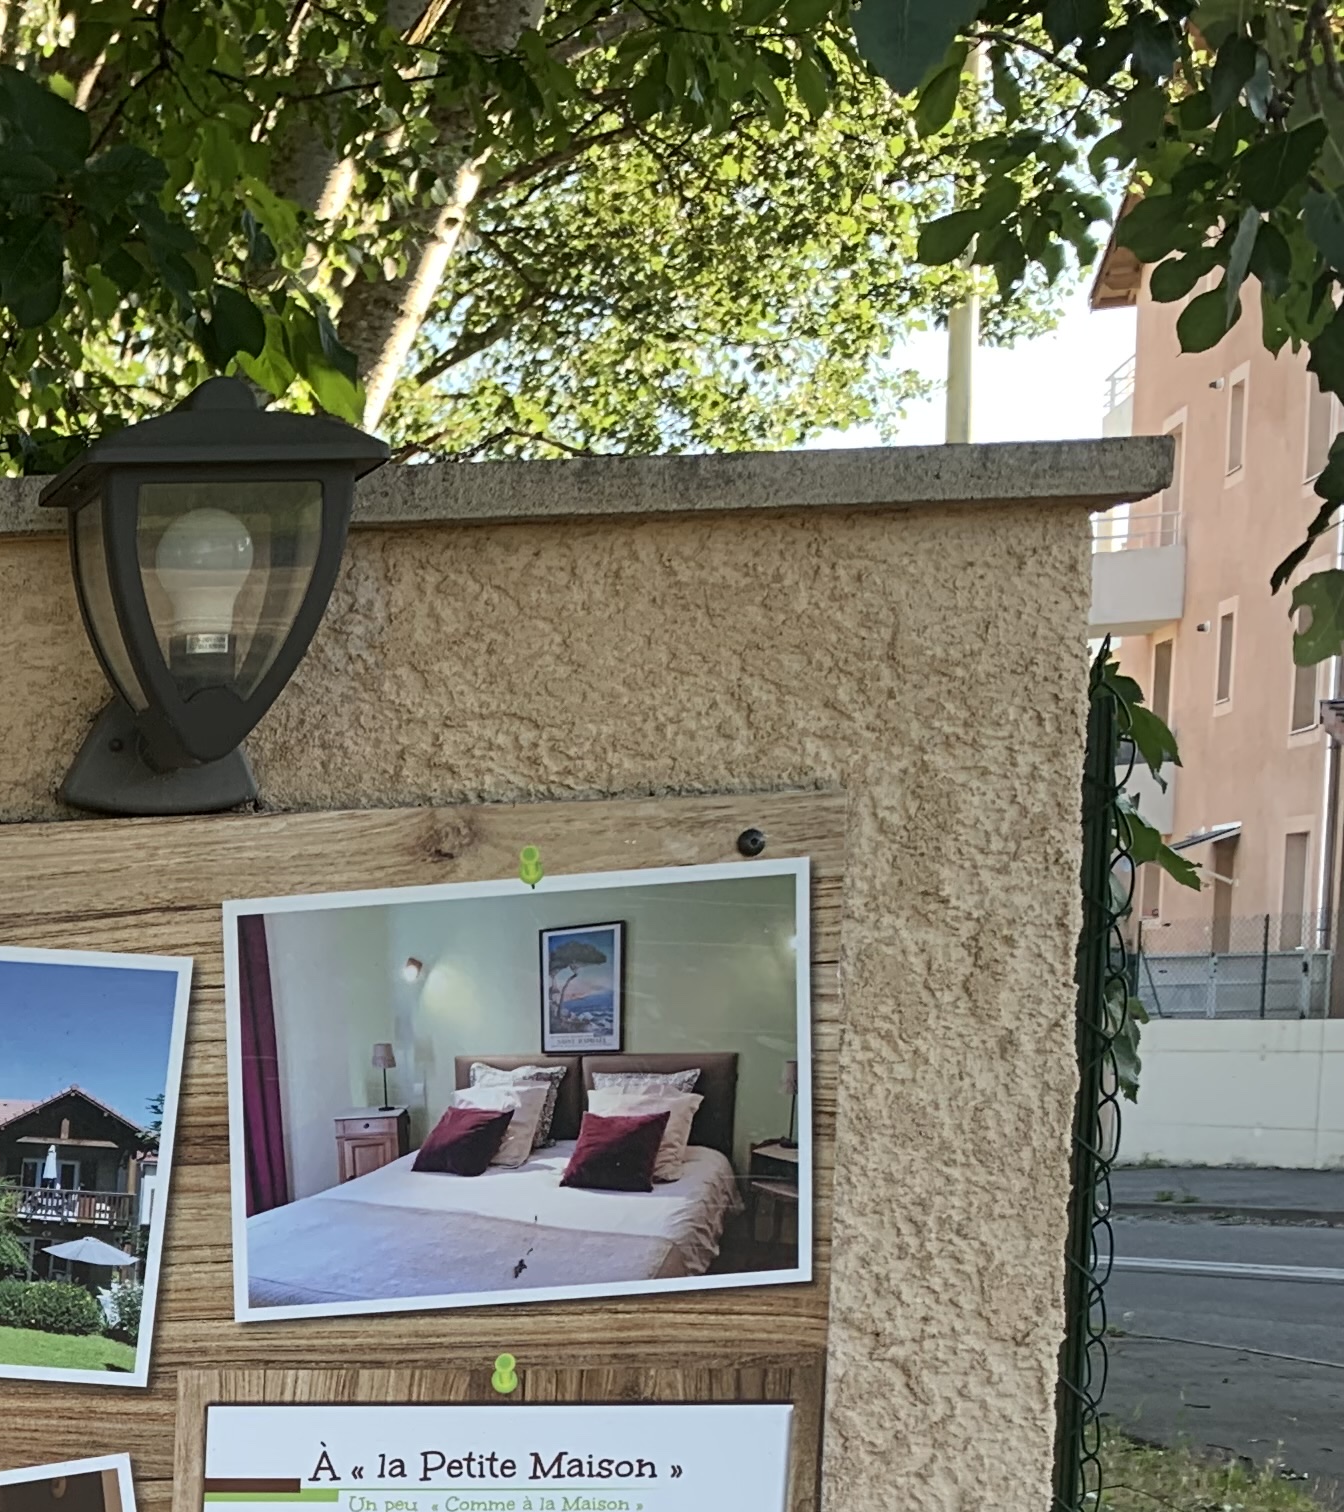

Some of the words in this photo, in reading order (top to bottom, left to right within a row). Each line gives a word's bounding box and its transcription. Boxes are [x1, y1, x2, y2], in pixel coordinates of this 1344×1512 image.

[308, 1441, 342, 1482] À
[377, 1453, 407, 1478] la
[419, 1450, 516, 1482] Petite
[528, 1451, 658, 1480] Maison
[349, 1495, 378, 1512] Un
[445, 1496, 516, 1512] Comme
[522, 1495, 533, 1511] à
[539, 1497, 556, 1511] la
[561, 1496, 630, 1512] Maison
